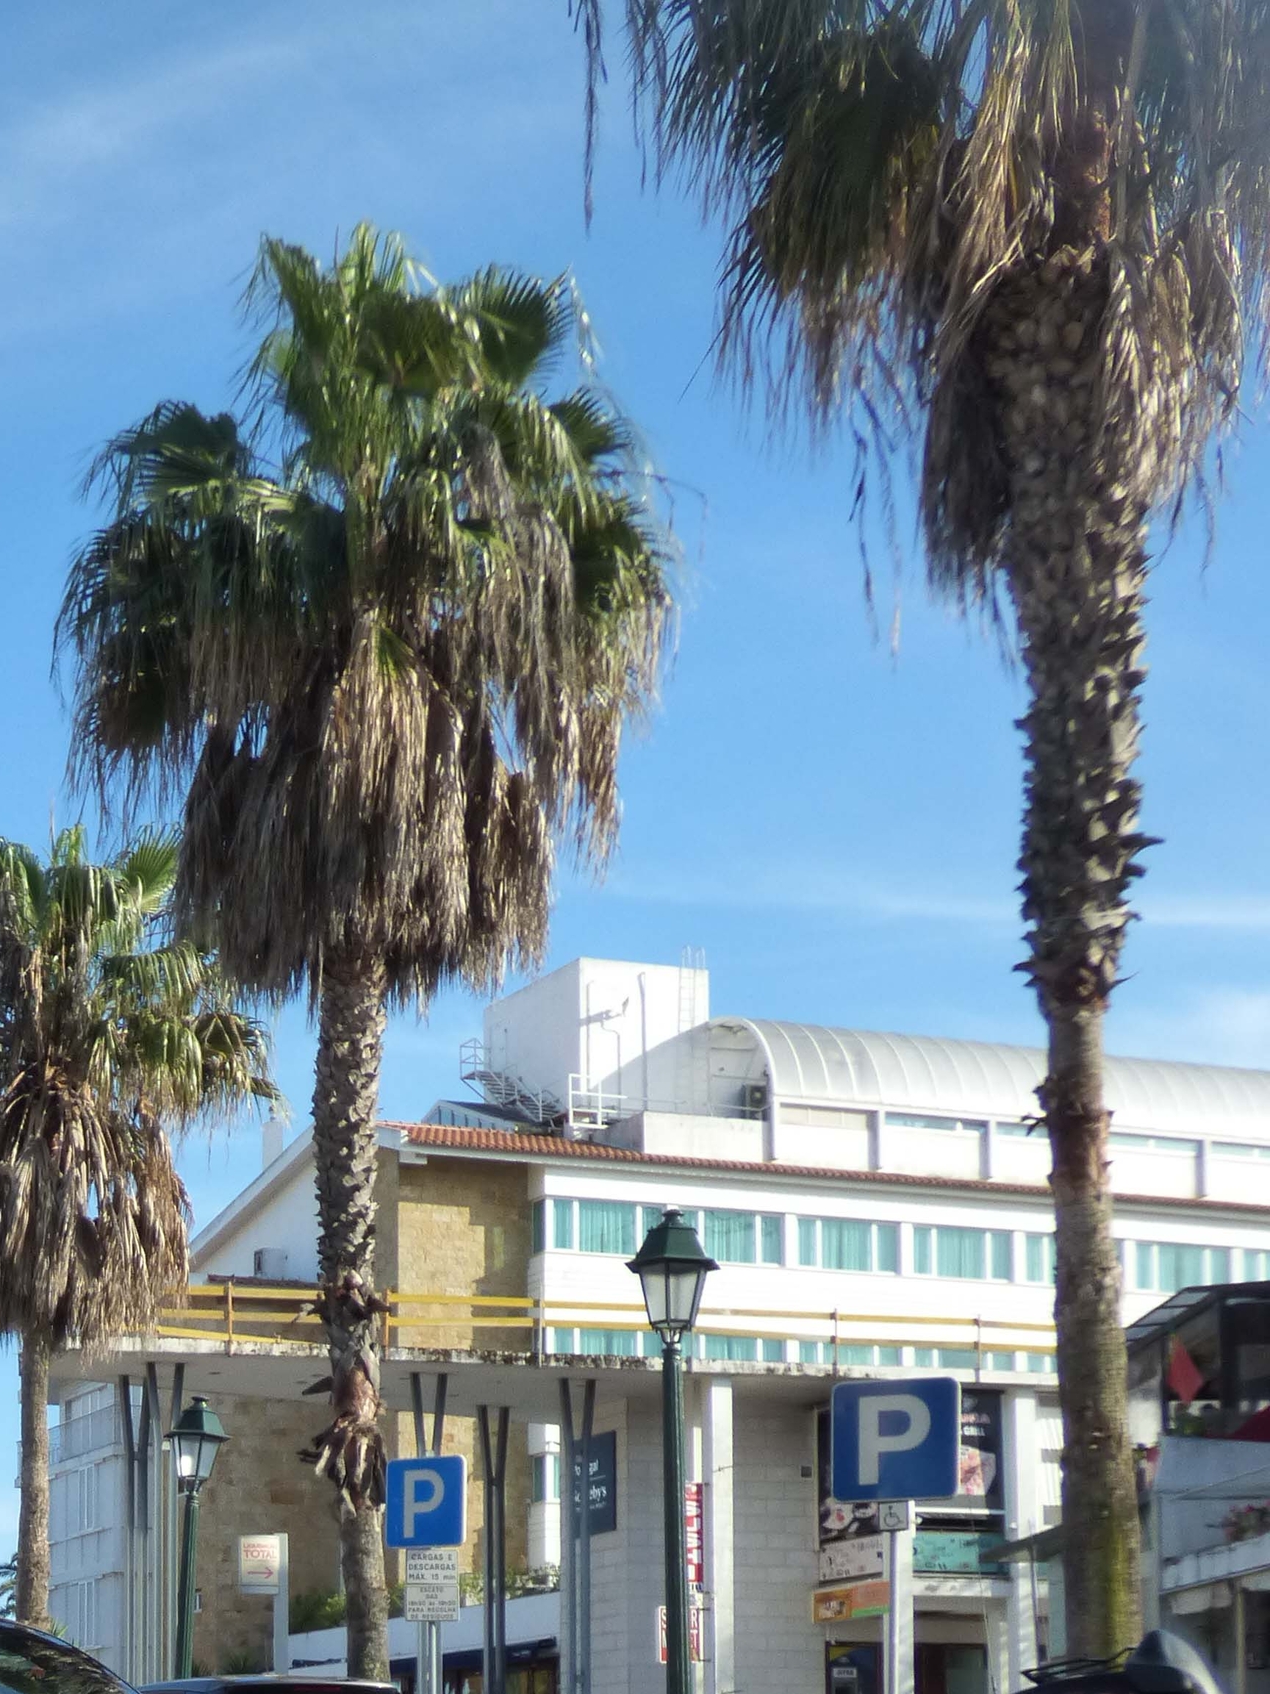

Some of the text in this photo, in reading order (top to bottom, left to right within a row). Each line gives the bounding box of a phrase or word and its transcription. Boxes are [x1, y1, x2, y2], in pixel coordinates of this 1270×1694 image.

[858, 1394, 931, 1486] P
[403, 1468, 445, 1539] P
[243, 1549, 277, 1559] TOTAL
[411, 1553, 444, 1561] CARGAS
[408, 1563, 456, 1571] DESCARGAS
